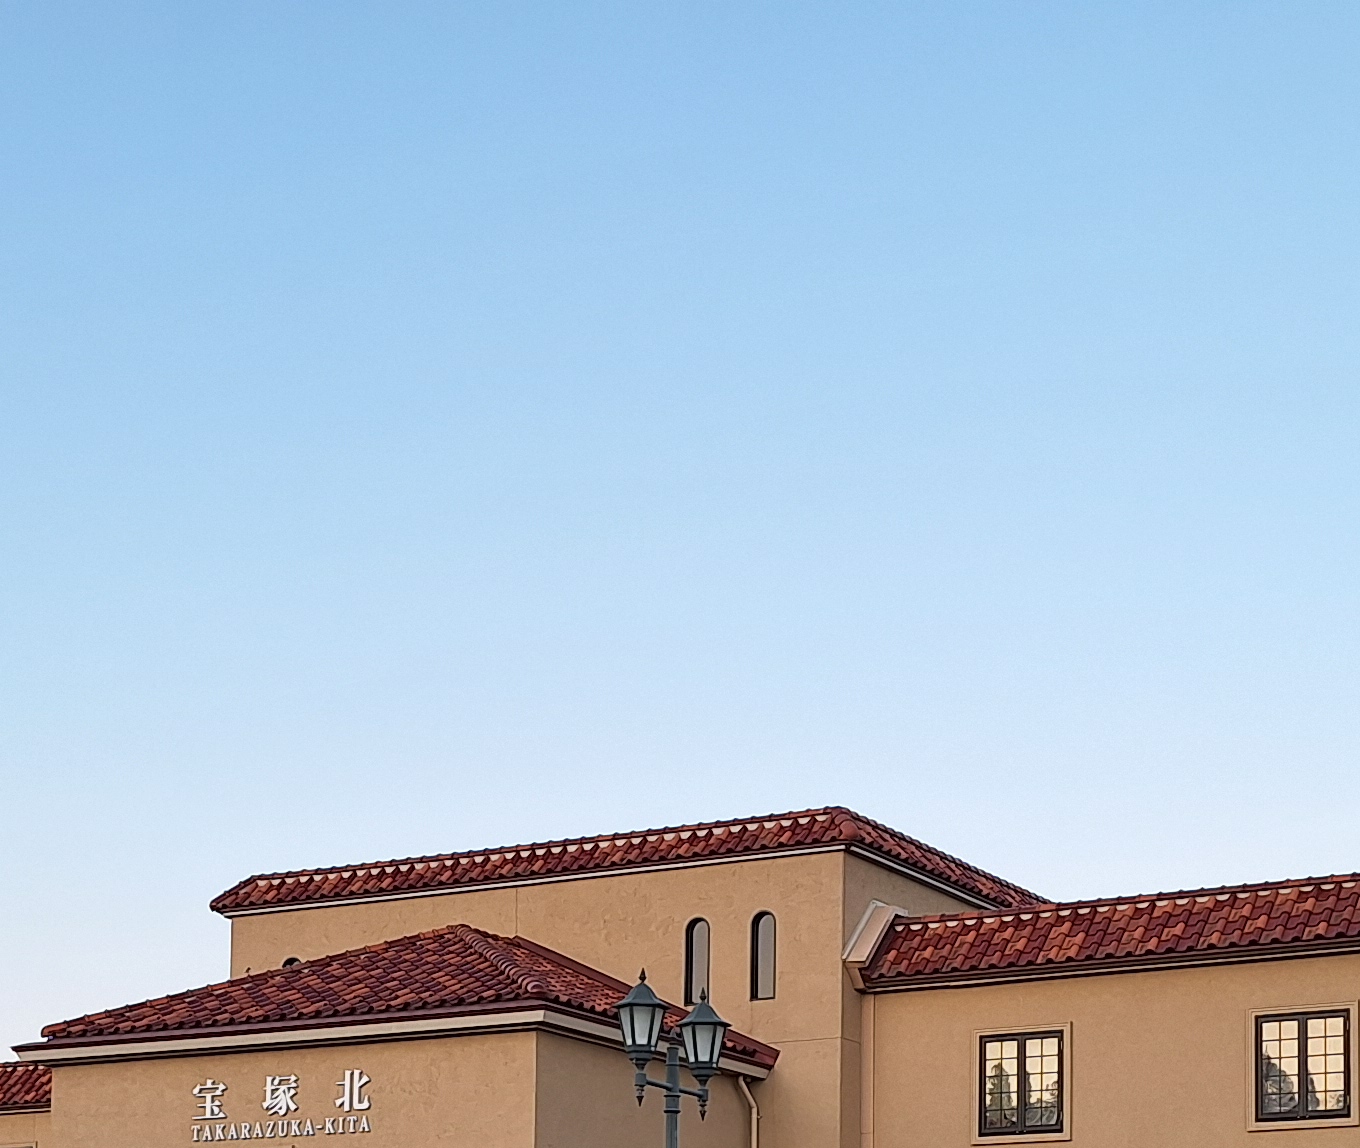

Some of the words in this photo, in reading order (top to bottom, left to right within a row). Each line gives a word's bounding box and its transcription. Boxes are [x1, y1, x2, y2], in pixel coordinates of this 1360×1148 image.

[192, 1069, 372, 1120] 宝塚北
[191, 1115, 371, 1142] TAKARAZUKA-KITA
